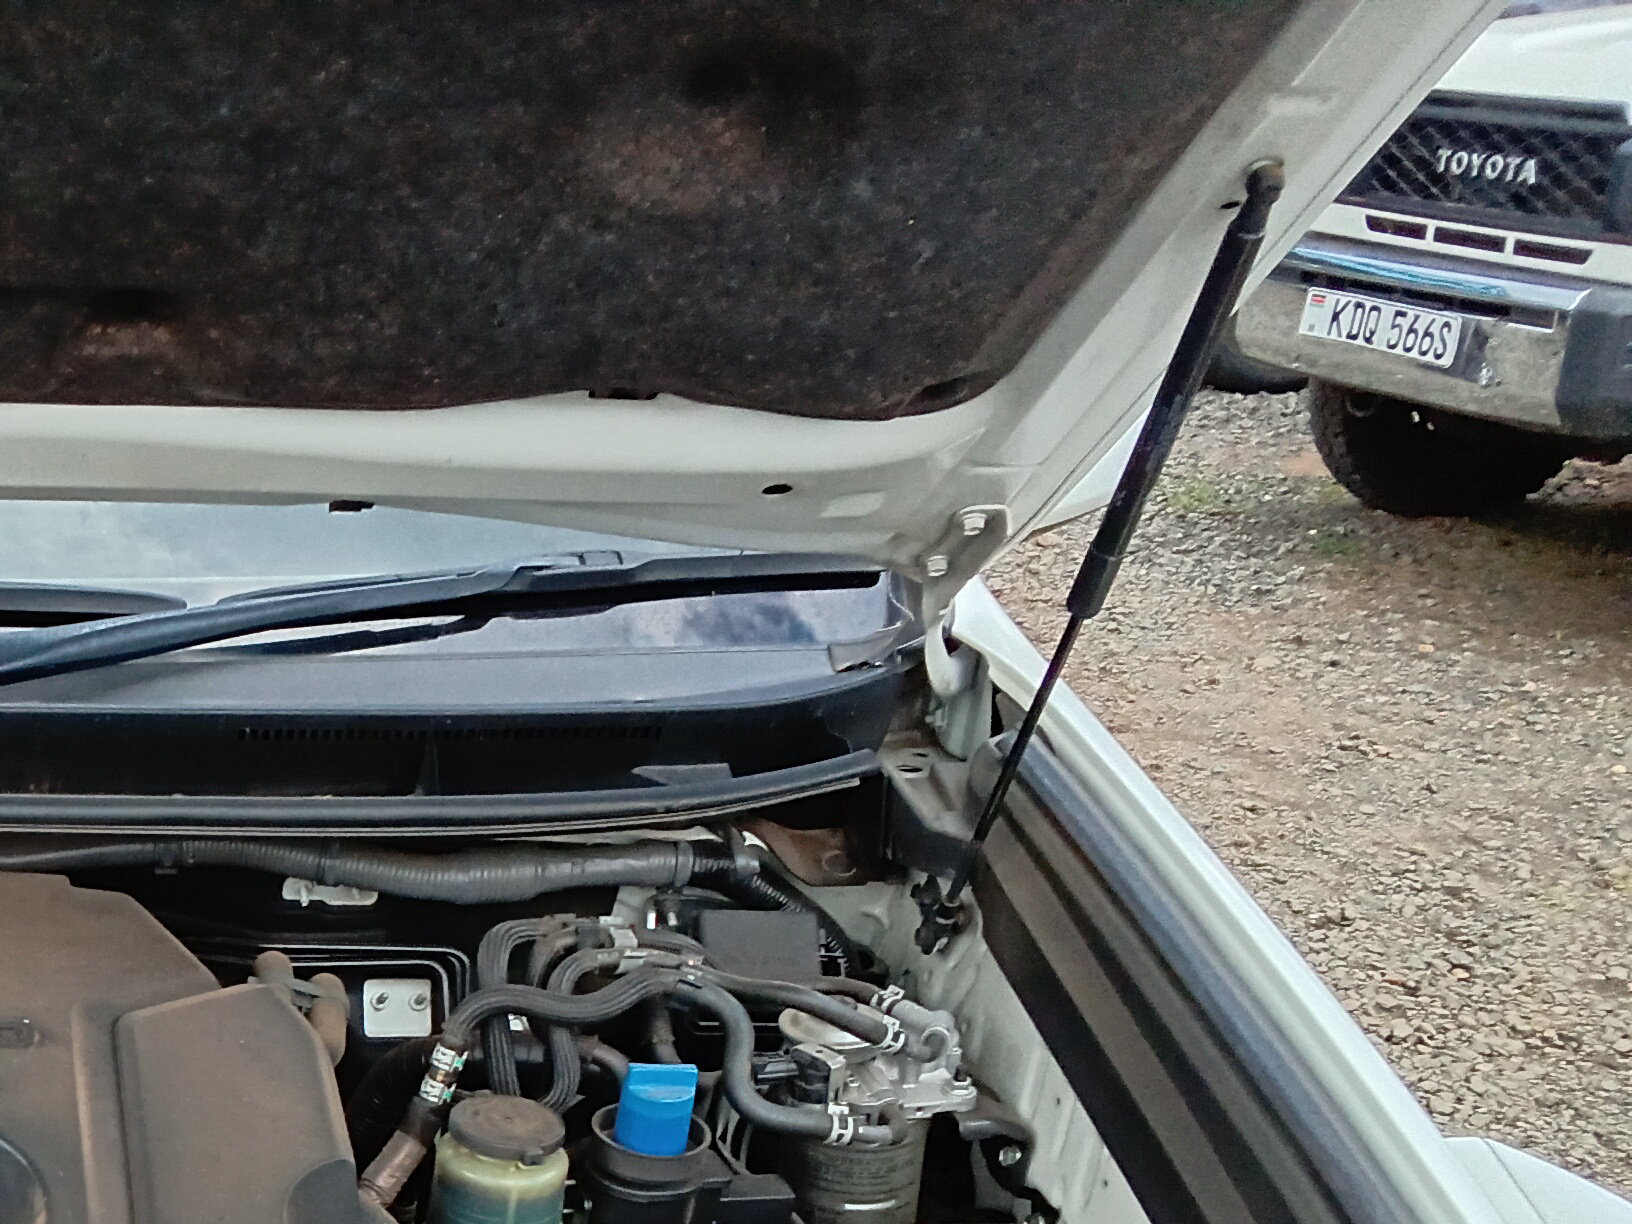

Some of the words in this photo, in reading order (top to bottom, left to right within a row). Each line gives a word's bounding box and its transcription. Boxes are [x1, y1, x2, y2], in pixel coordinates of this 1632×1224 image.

[1436, 148, 1537, 185] TOYOTA
[1326, 297, 1383, 346] KDQ
[1386, 309, 1453, 361] 566S
